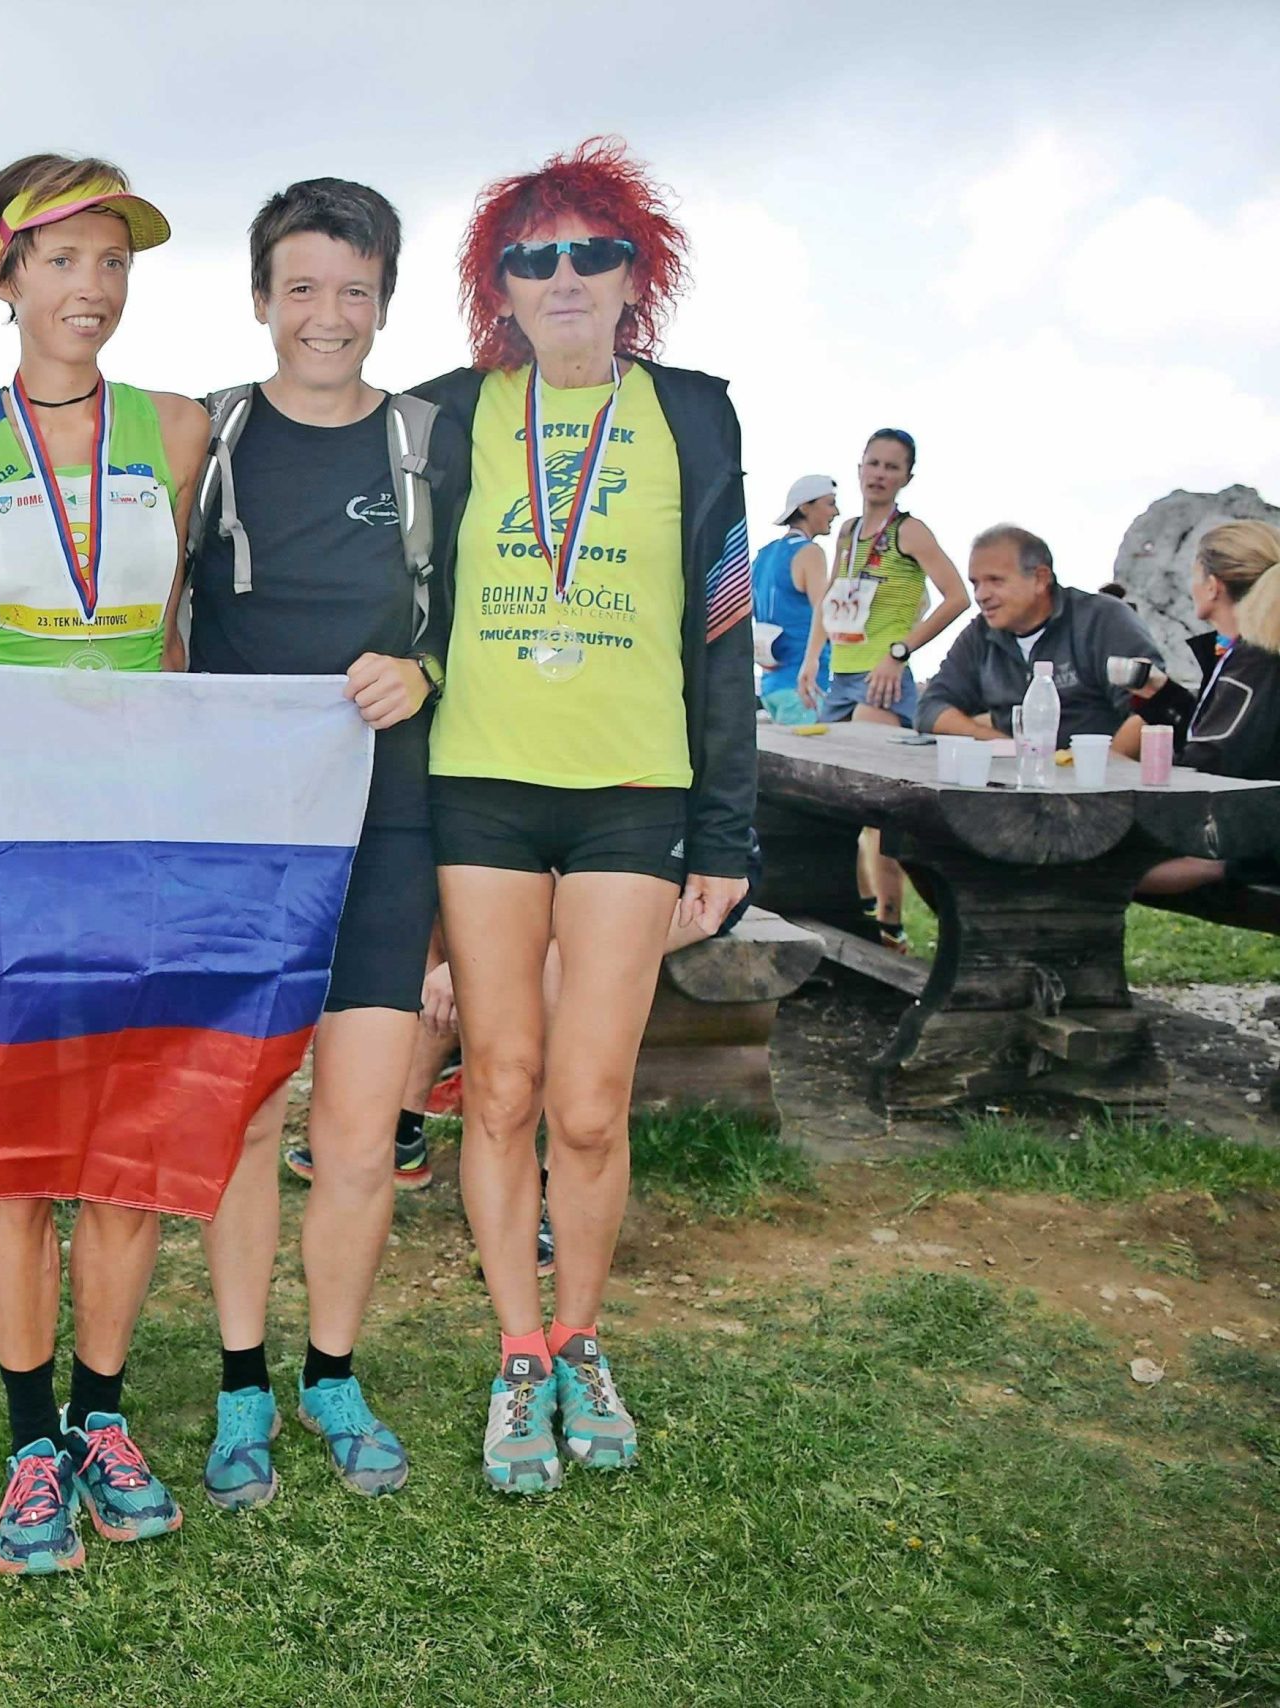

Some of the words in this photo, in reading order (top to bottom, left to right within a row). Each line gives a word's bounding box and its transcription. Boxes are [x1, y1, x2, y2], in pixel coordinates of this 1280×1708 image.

[515, 422, 590, 442] GRSKI
[605, 427, 636, 444] EK
[497, 543, 562, 559] VOG
[578, 545, 627, 564] 2015
[482, 586, 548, 602] BOHINJ
[481, 603, 546, 615] SLOVENIJA
[53, 616, 71, 627] TEK
[88, 614, 128, 627] ATITOVEC
